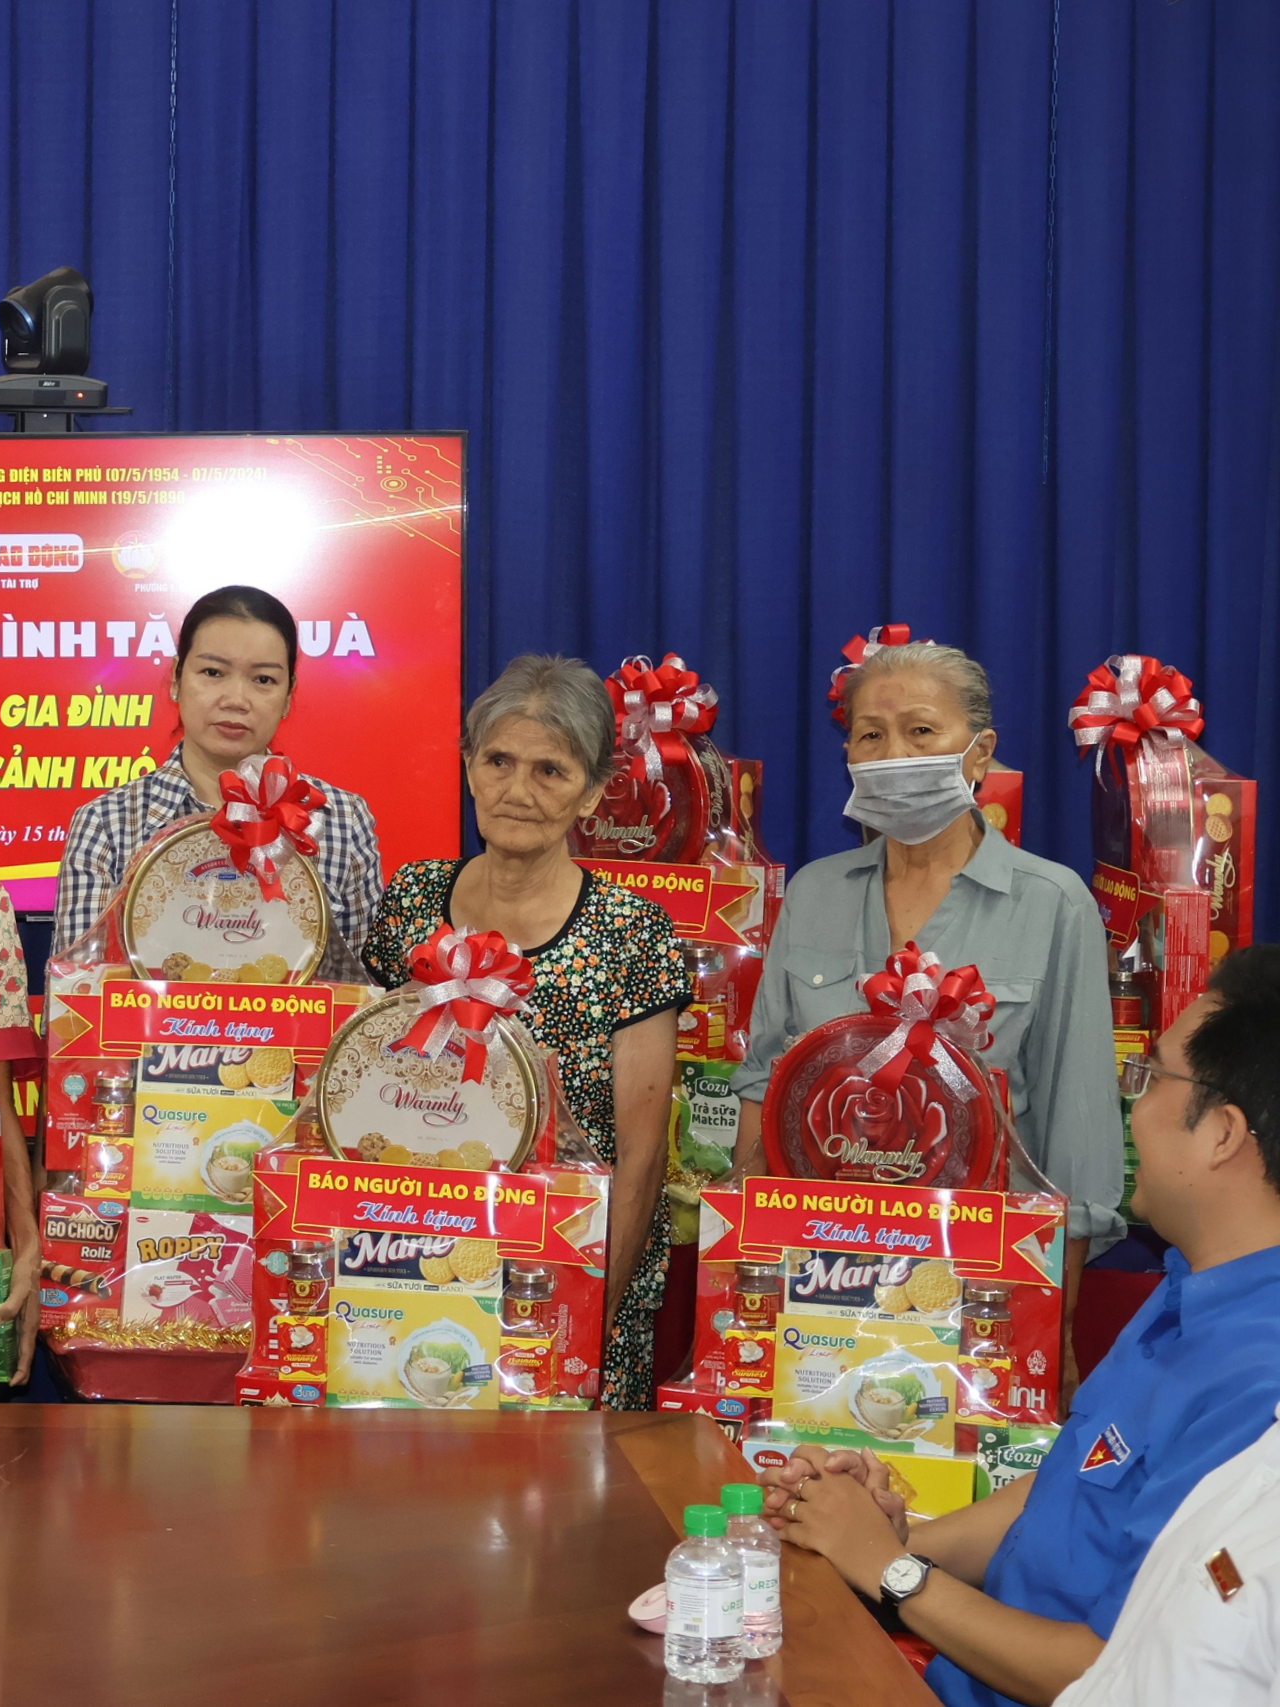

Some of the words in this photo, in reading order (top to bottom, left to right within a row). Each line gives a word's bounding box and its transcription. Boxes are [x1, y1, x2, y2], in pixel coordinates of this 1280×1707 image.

[9, 466, 39, 485] ĐIỆN
[43, 466, 72, 483] BIÊN
[76, 465, 102, 483] PHỦ
[106, 467, 179, 482] (07/5/1954
[25, 487, 43, 505] HỒ
[47, 489, 69, 505] CHÍ
[73, 491, 107, 505] MINH
[28, 543, 80, 568] ĐỘNG
[1, 577, 16, 588] TÀI
[19, 578, 39, 590] TRỢ
[298, 612, 376, 658] UÀ
[0, 694, 60, 728] GIA
[67, 685, 153, 728] ĐÌNH
[22, 826, 43, 842] 15
[582, 815, 657, 854] Warmly
[616, 873, 649, 887] LAO
[652, 873, 705, 893] ĐỘNG
[1114, 881, 1136, 902] ĐỘNG
[183, 905, 266, 944] Warmly
[110, 989, 144, 1009] BÁO
[157, 988, 223, 1011] NGƯỜI
[228, 994, 266, 1012] LAO
[270, 994, 327, 1018] ĐỘNG
[159, 1017, 220, 1037] Kính
[223, 1019, 275, 1041] tặng
[148, 1045, 252, 1075] Marie
[698, 1079, 729, 1096] Cozy
[142, 1104, 207, 1126] Quasure
[379, 1082, 468, 1127] Warmly
[692, 1100, 709, 1114] Trà
[712, 1099, 737, 1116] sữa
[692, 1113, 736, 1127] Matcha
[824, 1133, 926, 1181] Warmly
[308, 1170, 349, 1191] BÁO
[353, 1172, 422, 1196] NGƯỜI
[427, 1180, 468, 1200] LAO
[473, 1181, 536, 1206] ĐỘNG
[353, 1201, 419, 1224] Kính
[423, 1208, 477, 1232] tặng
[755, 1190, 797, 1210] BÁO
[803, 1191, 874, 1216] NGƯỜI
[880, 1199, 923, 1218] LAO
[928, 1197, 993, 1224] ĐỘNG
[47, 1220, 66, 1238] GO
[68, 1222, 114, 1241] CHOCO
[803, 1219, 870, 1243] Kính
[874, 1225, 932, 1251] tặng
[81, 1245, 112, 1259] Rollz
[137, 1236, 224, 1263] ROPPY
[345, 1233, 454, 1269] Marie
[387, 1280, 404, 1290] SỮA
[441, 1285, 463, 1293] CANXI
[795, 1256, 912, 1296] Marie
[335, 1301, 404, 1323] Quasure
[840, 1307, 857, 1318] SỮA
[896, 1313, 920, 1322] CANXI
[347, 1341, 386, 1349] NUTRITIOUS
[783, 1327, 857, 1350] Quasure
[350, 1348, 382, 1356] SOLUTION
[795, 1369, 836, 1378] NUTRITIOUS
[798, 1376, 832, 1385] SOLUTION
[758, 1455, 784, 1466] Roma
[1003, 1449, 1043, 1468] Cozy
